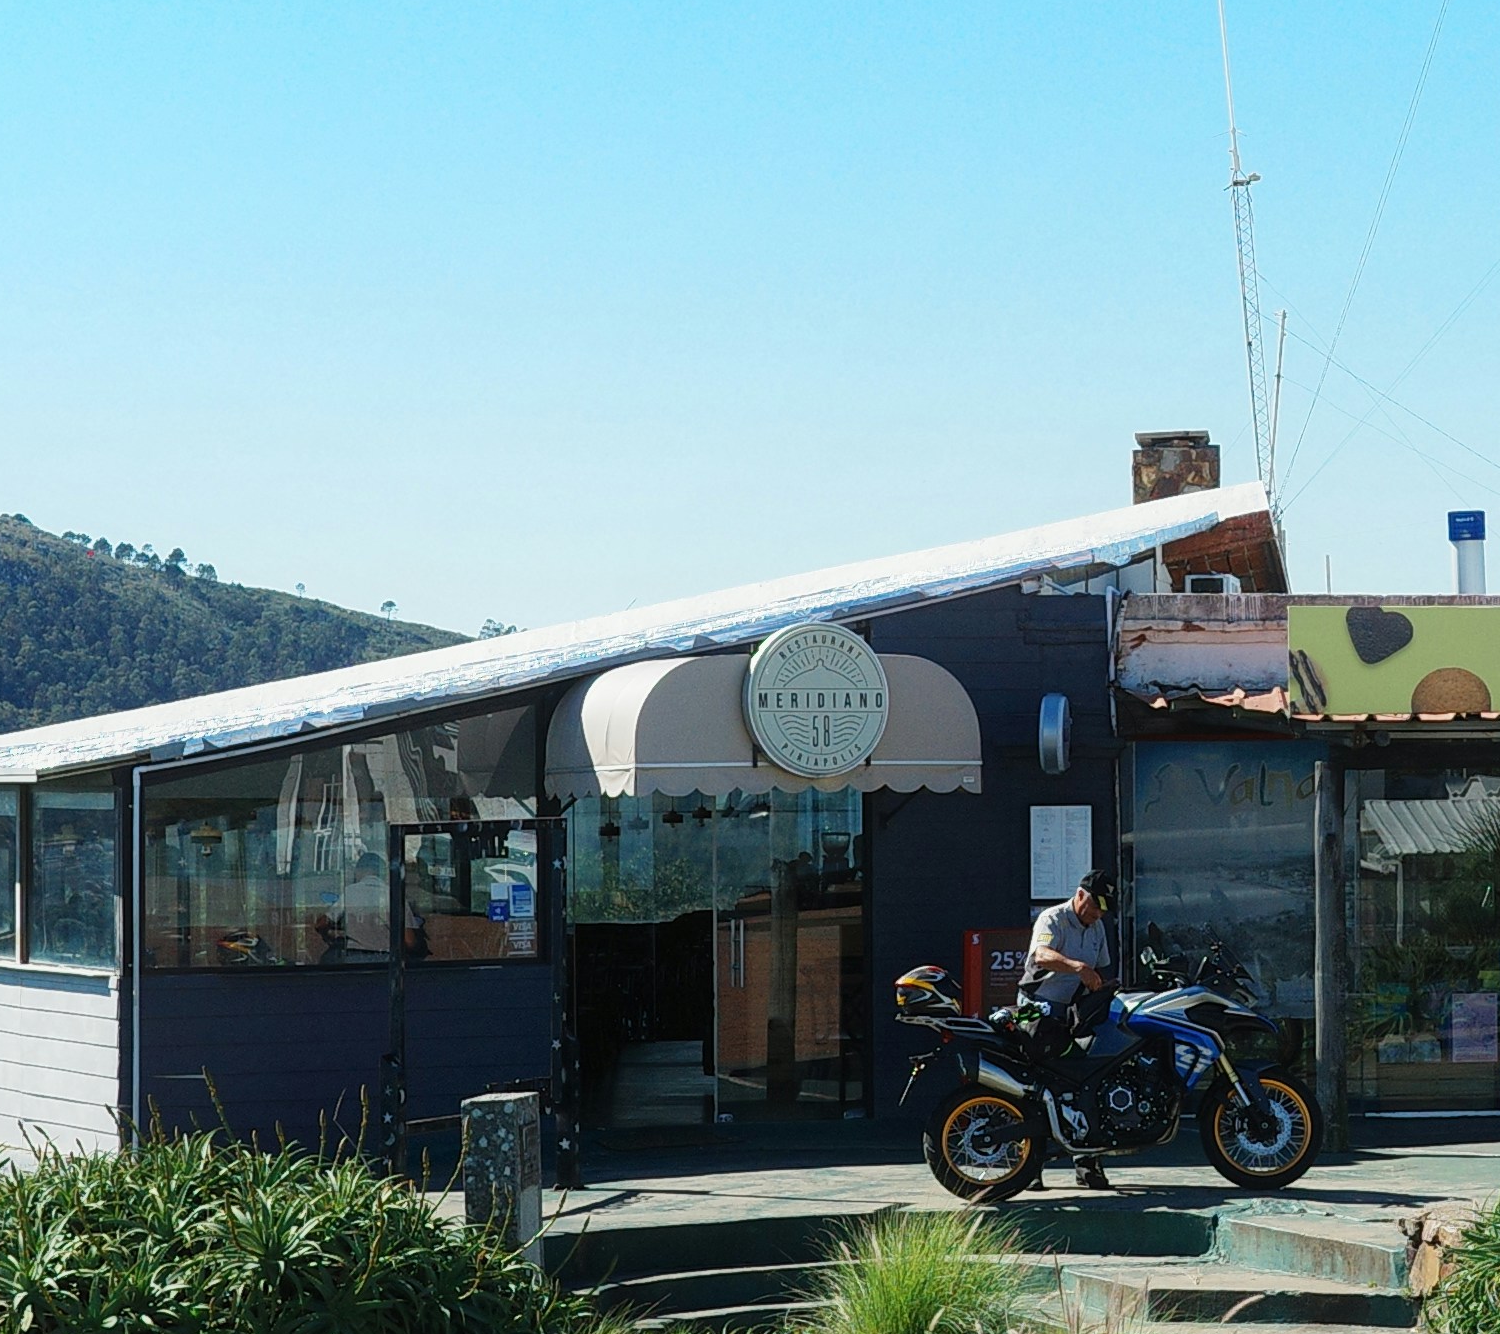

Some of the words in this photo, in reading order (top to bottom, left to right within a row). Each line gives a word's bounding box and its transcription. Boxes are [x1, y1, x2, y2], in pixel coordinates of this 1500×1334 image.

[778, 635, 862, 660] RESTAURANT
[758, 692, 884, 709] MERIDIANO
[812, 714, 831, 748] 58
[781, 743, 862, 767] PIRIAPOLIS
[512, 922, 532, 931] VISA
